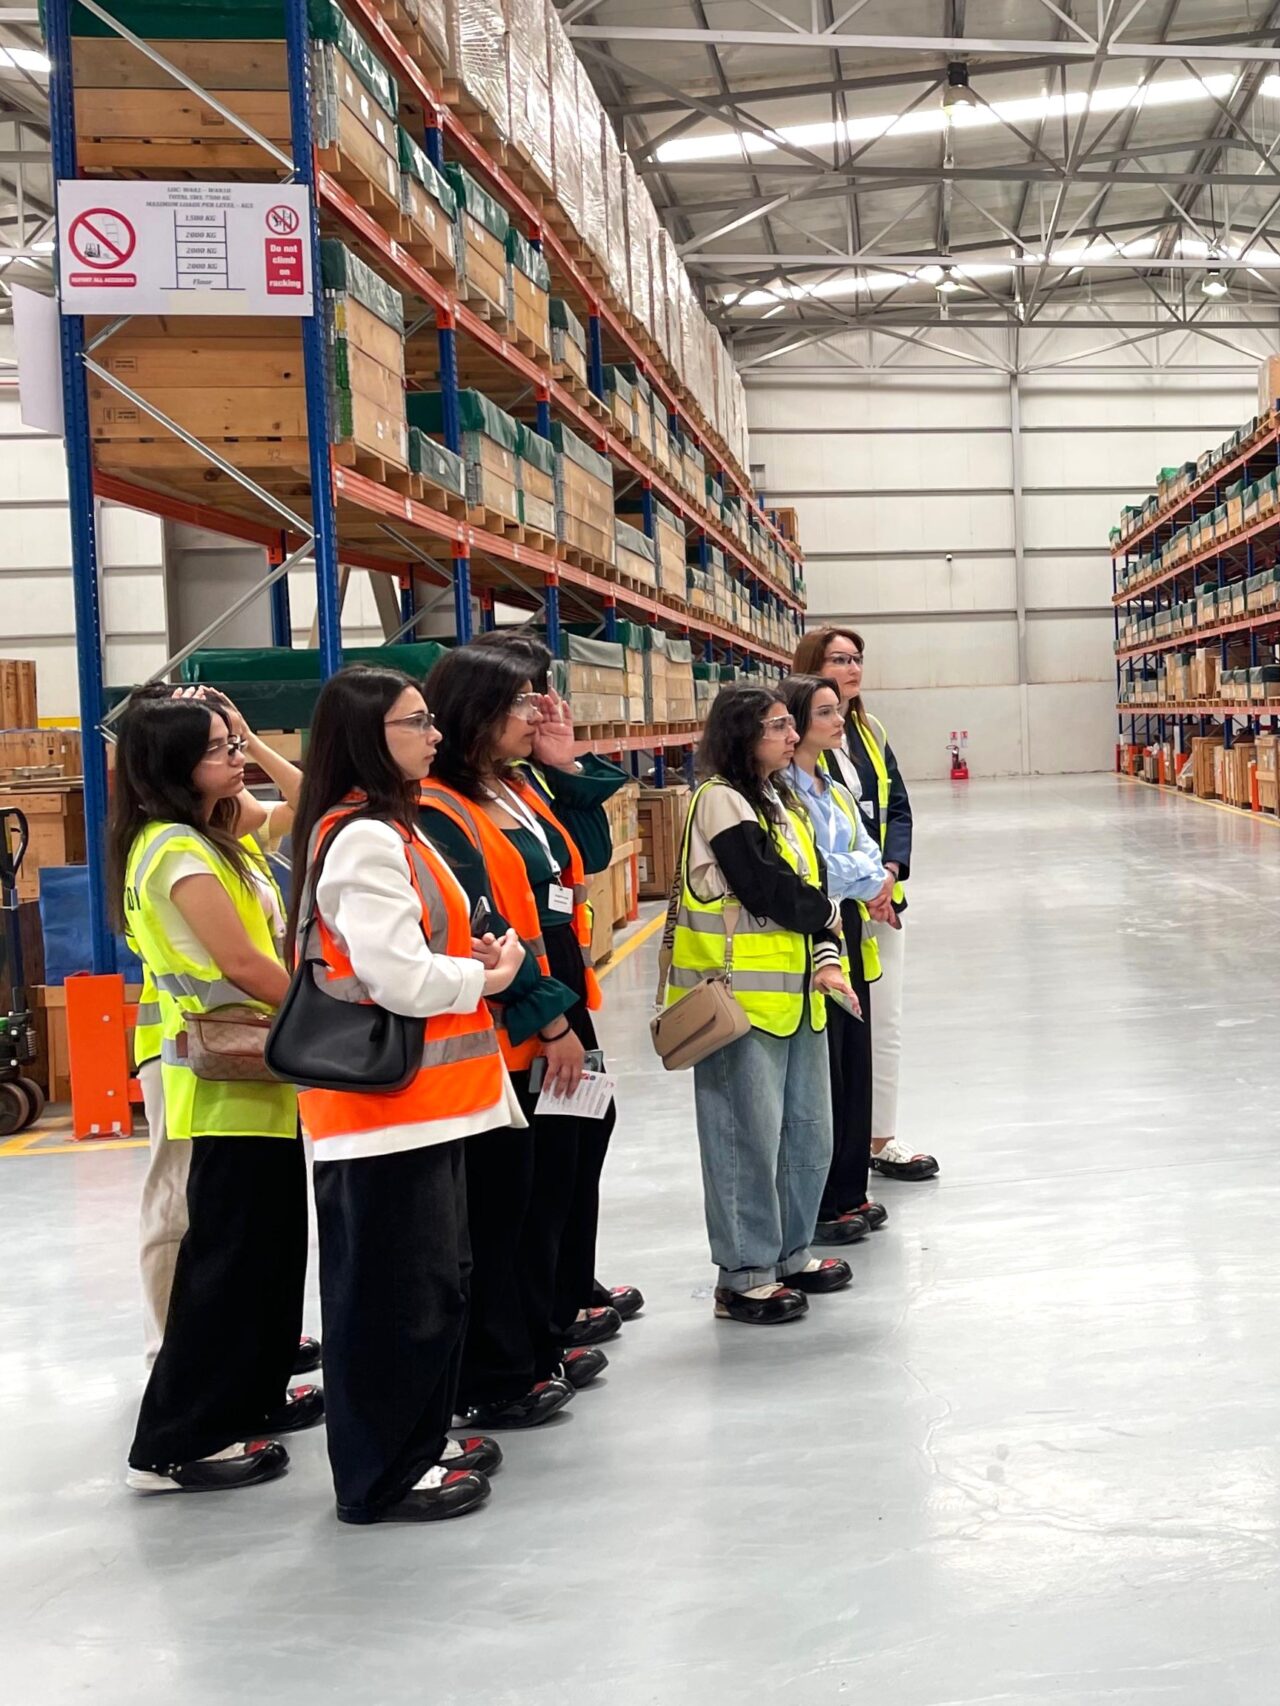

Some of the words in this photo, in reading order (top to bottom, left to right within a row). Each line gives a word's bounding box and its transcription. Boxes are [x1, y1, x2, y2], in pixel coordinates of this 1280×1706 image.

[270, 244, 281, 253] Do
[283, 245, 298, 253] not
[272, 256, 296, 265] climb
[269, 279, 301, 289] racking
